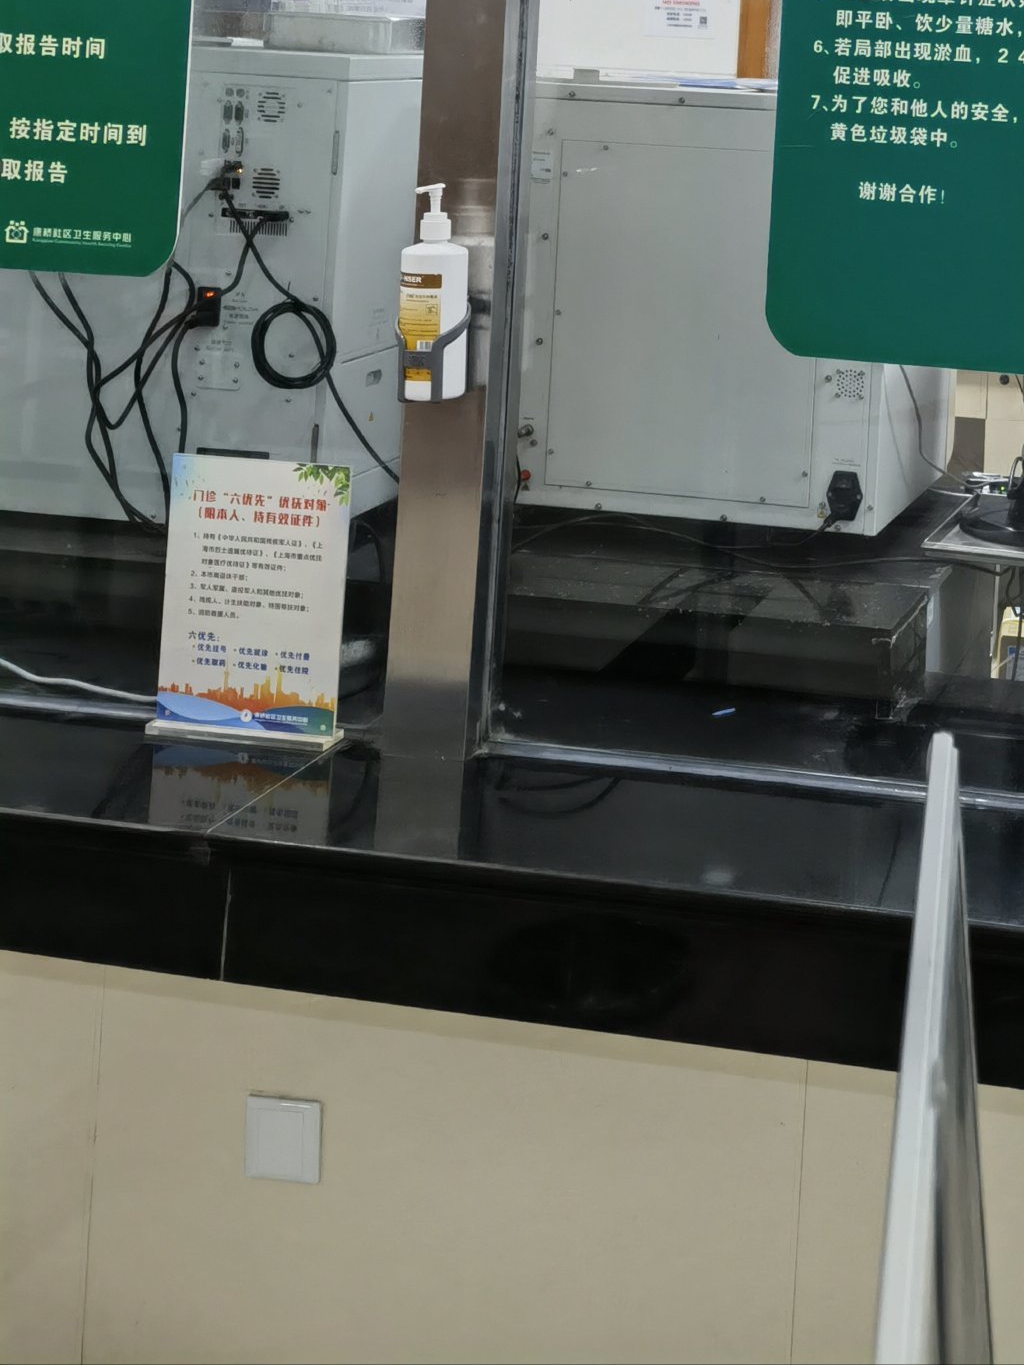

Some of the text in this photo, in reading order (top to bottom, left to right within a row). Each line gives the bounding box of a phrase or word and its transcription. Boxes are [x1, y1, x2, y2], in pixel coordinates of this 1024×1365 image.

[833, 66, 920, 89] 促进吸收。
[9, 117, 148, 147] 按指定时间到
[830, 122, 957, 148] 黄色垃圾袋中。
[0, 157, 69, 185] 取报告
[858, 181, 944, 204] 谢谢合作！
